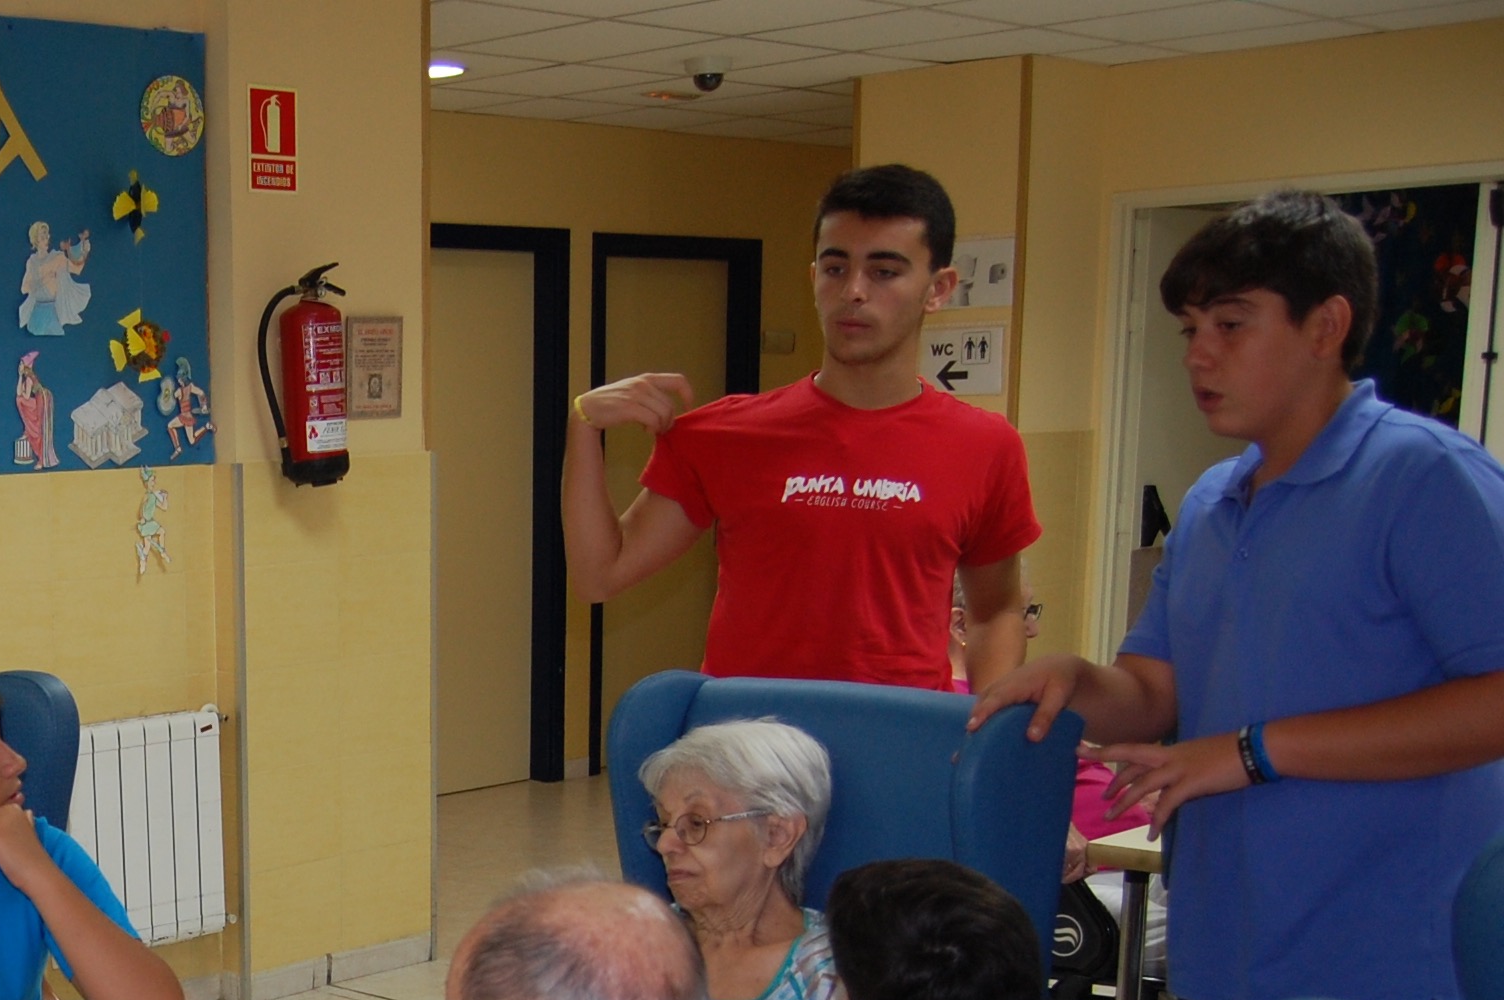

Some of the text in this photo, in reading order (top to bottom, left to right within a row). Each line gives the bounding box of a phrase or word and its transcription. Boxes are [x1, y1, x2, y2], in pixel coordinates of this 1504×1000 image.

[931, 343, 954, 356] WC
[781, 475, 844, 503] PUNTA
[851, 499, 888, 511] COURSE
